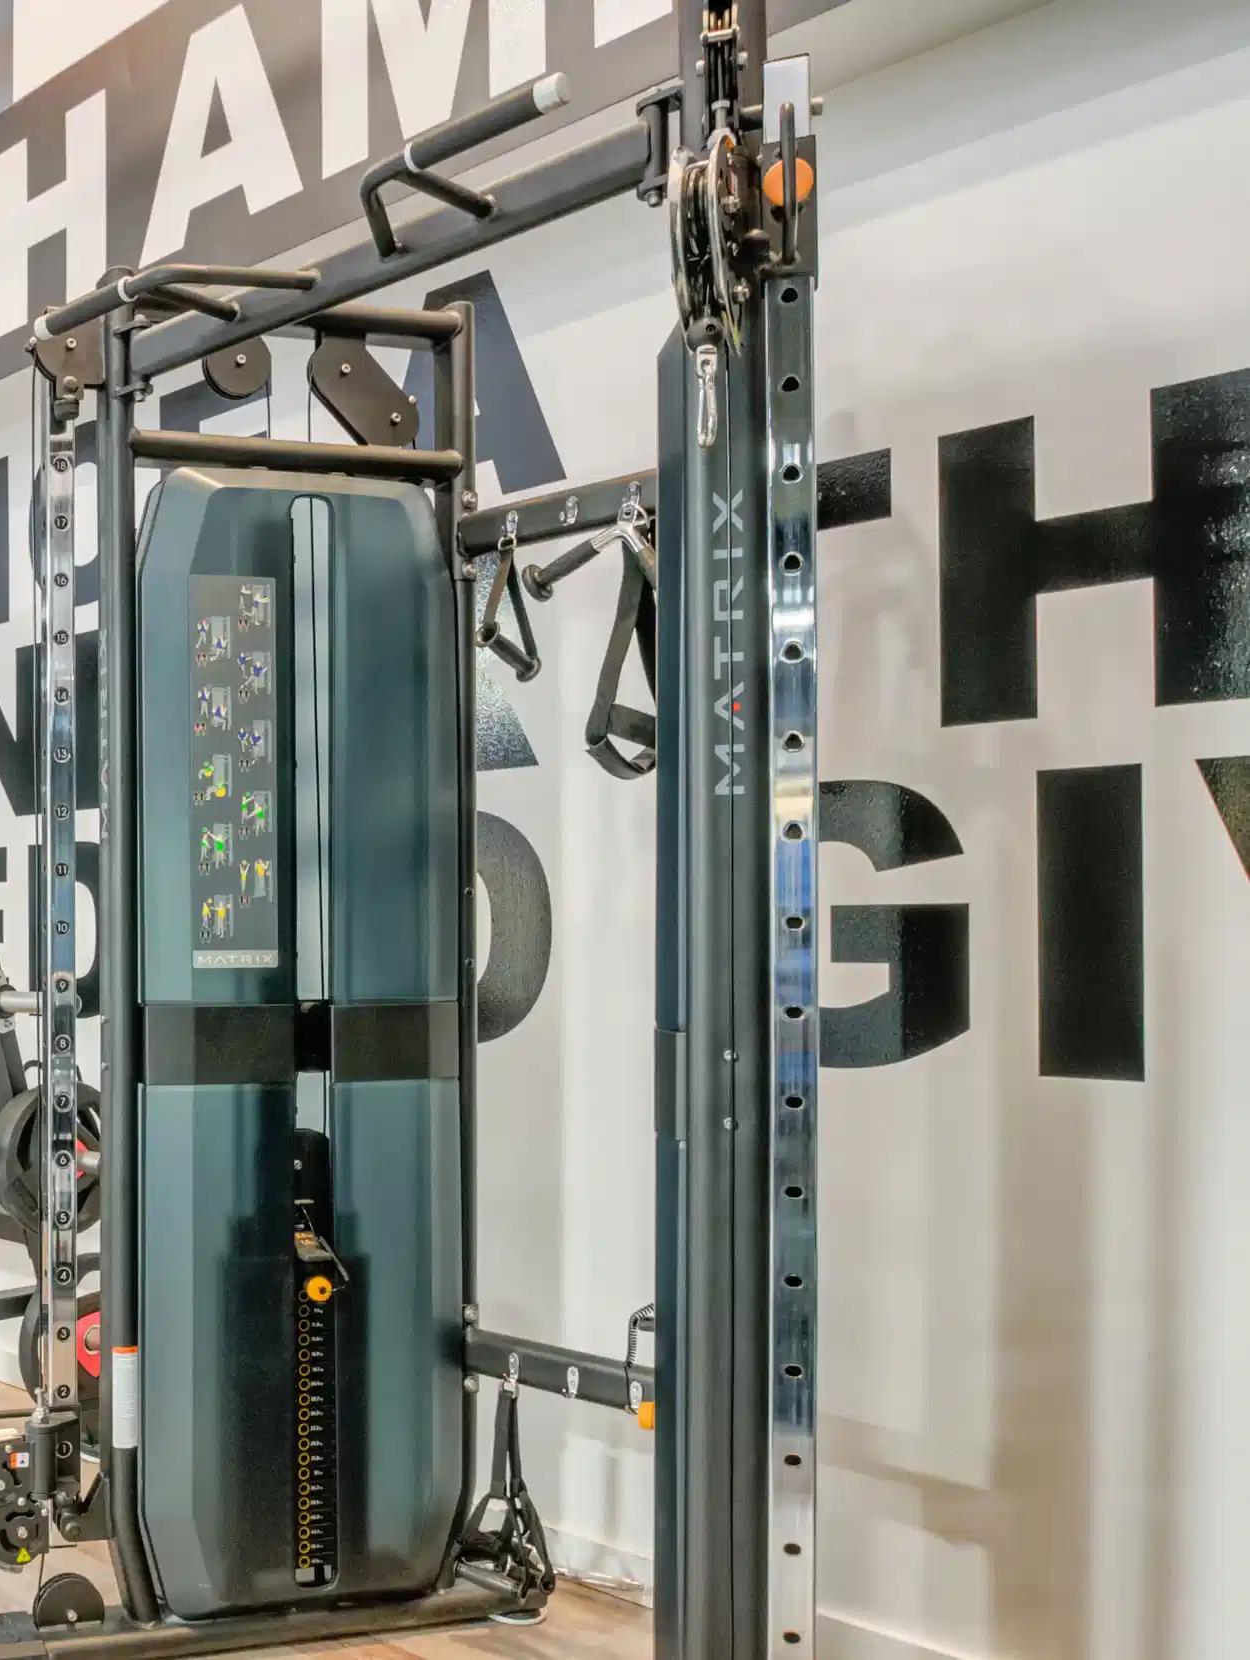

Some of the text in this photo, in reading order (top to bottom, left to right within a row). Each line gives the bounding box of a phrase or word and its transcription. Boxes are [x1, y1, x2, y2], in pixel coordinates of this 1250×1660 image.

[712, 488, 746, 796] MATRIX
[197, 954, 274, 966] MATRIX
[818, 755, 1250, 1082] GI
